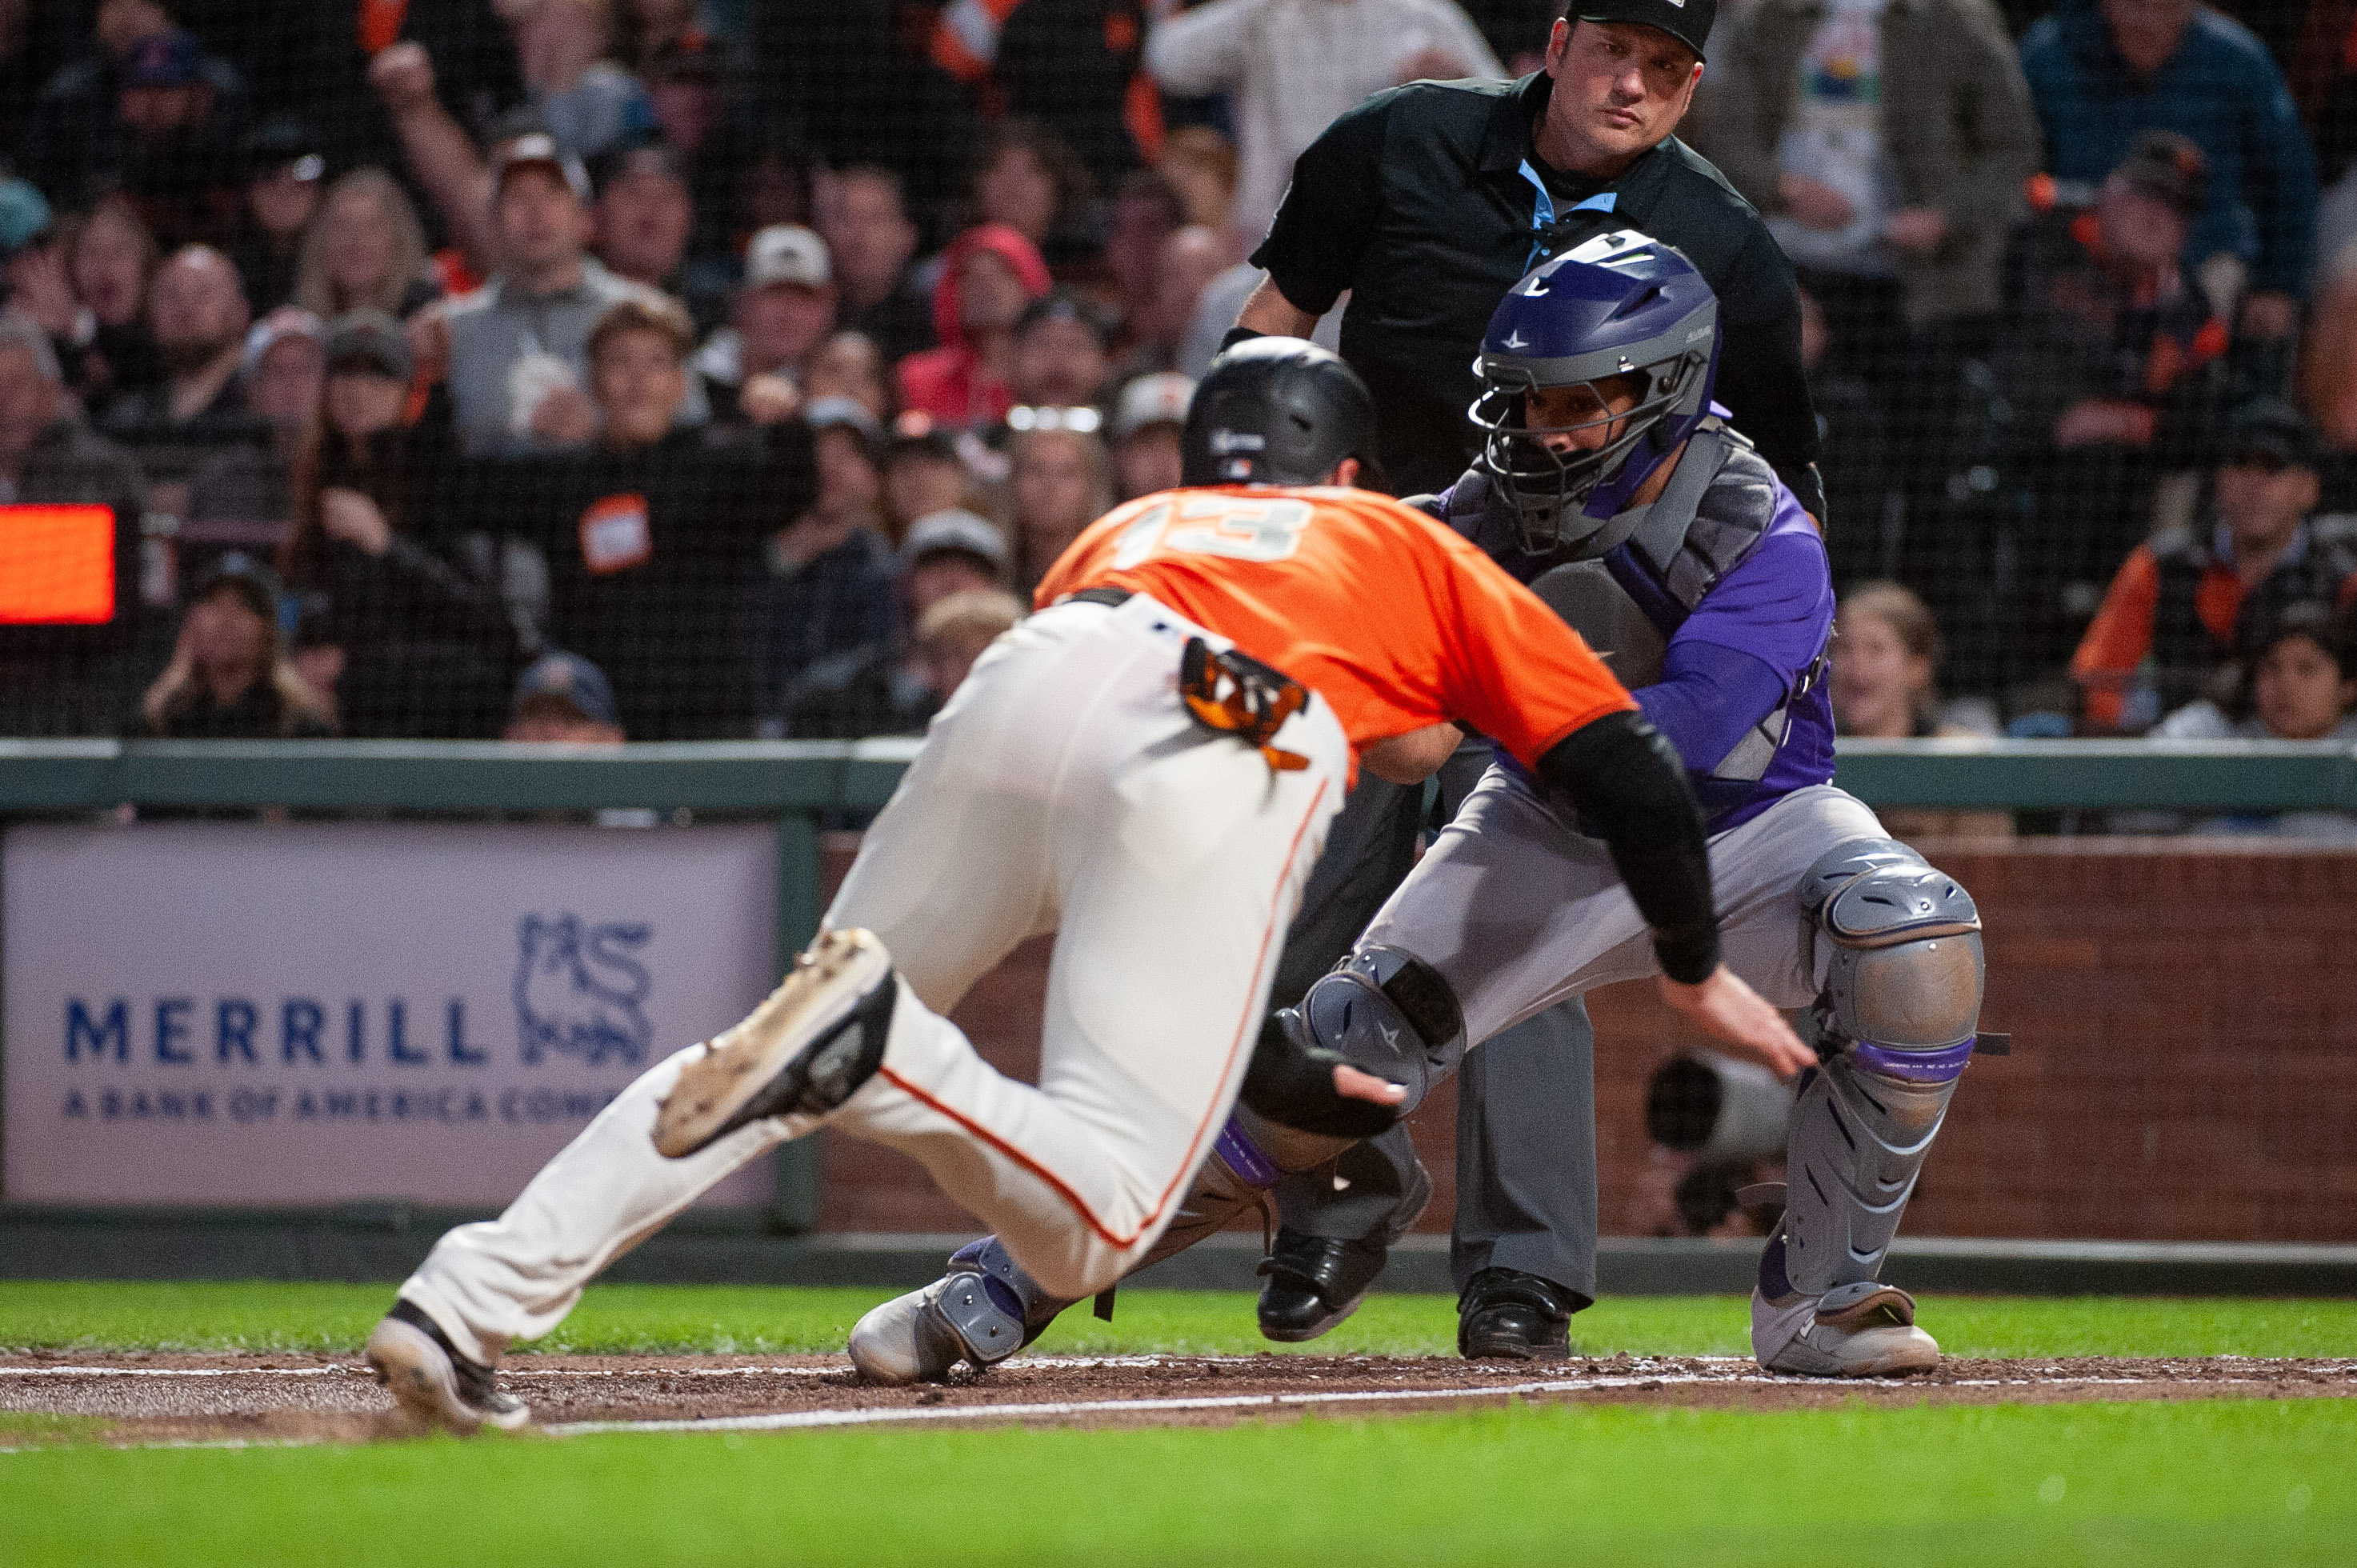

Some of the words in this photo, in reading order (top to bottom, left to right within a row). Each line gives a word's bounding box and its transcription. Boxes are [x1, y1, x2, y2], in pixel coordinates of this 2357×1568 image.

[1111, 495, 1313, 570] 13
[64, 998, 487, 1064] MERRILL
[63, 1090, 87, 1120] A
[100, 1089, 213, 1120] BANK
[228, 1087, 278, 1121] OF
[294, 1089, 486, 1121] AMERICA
